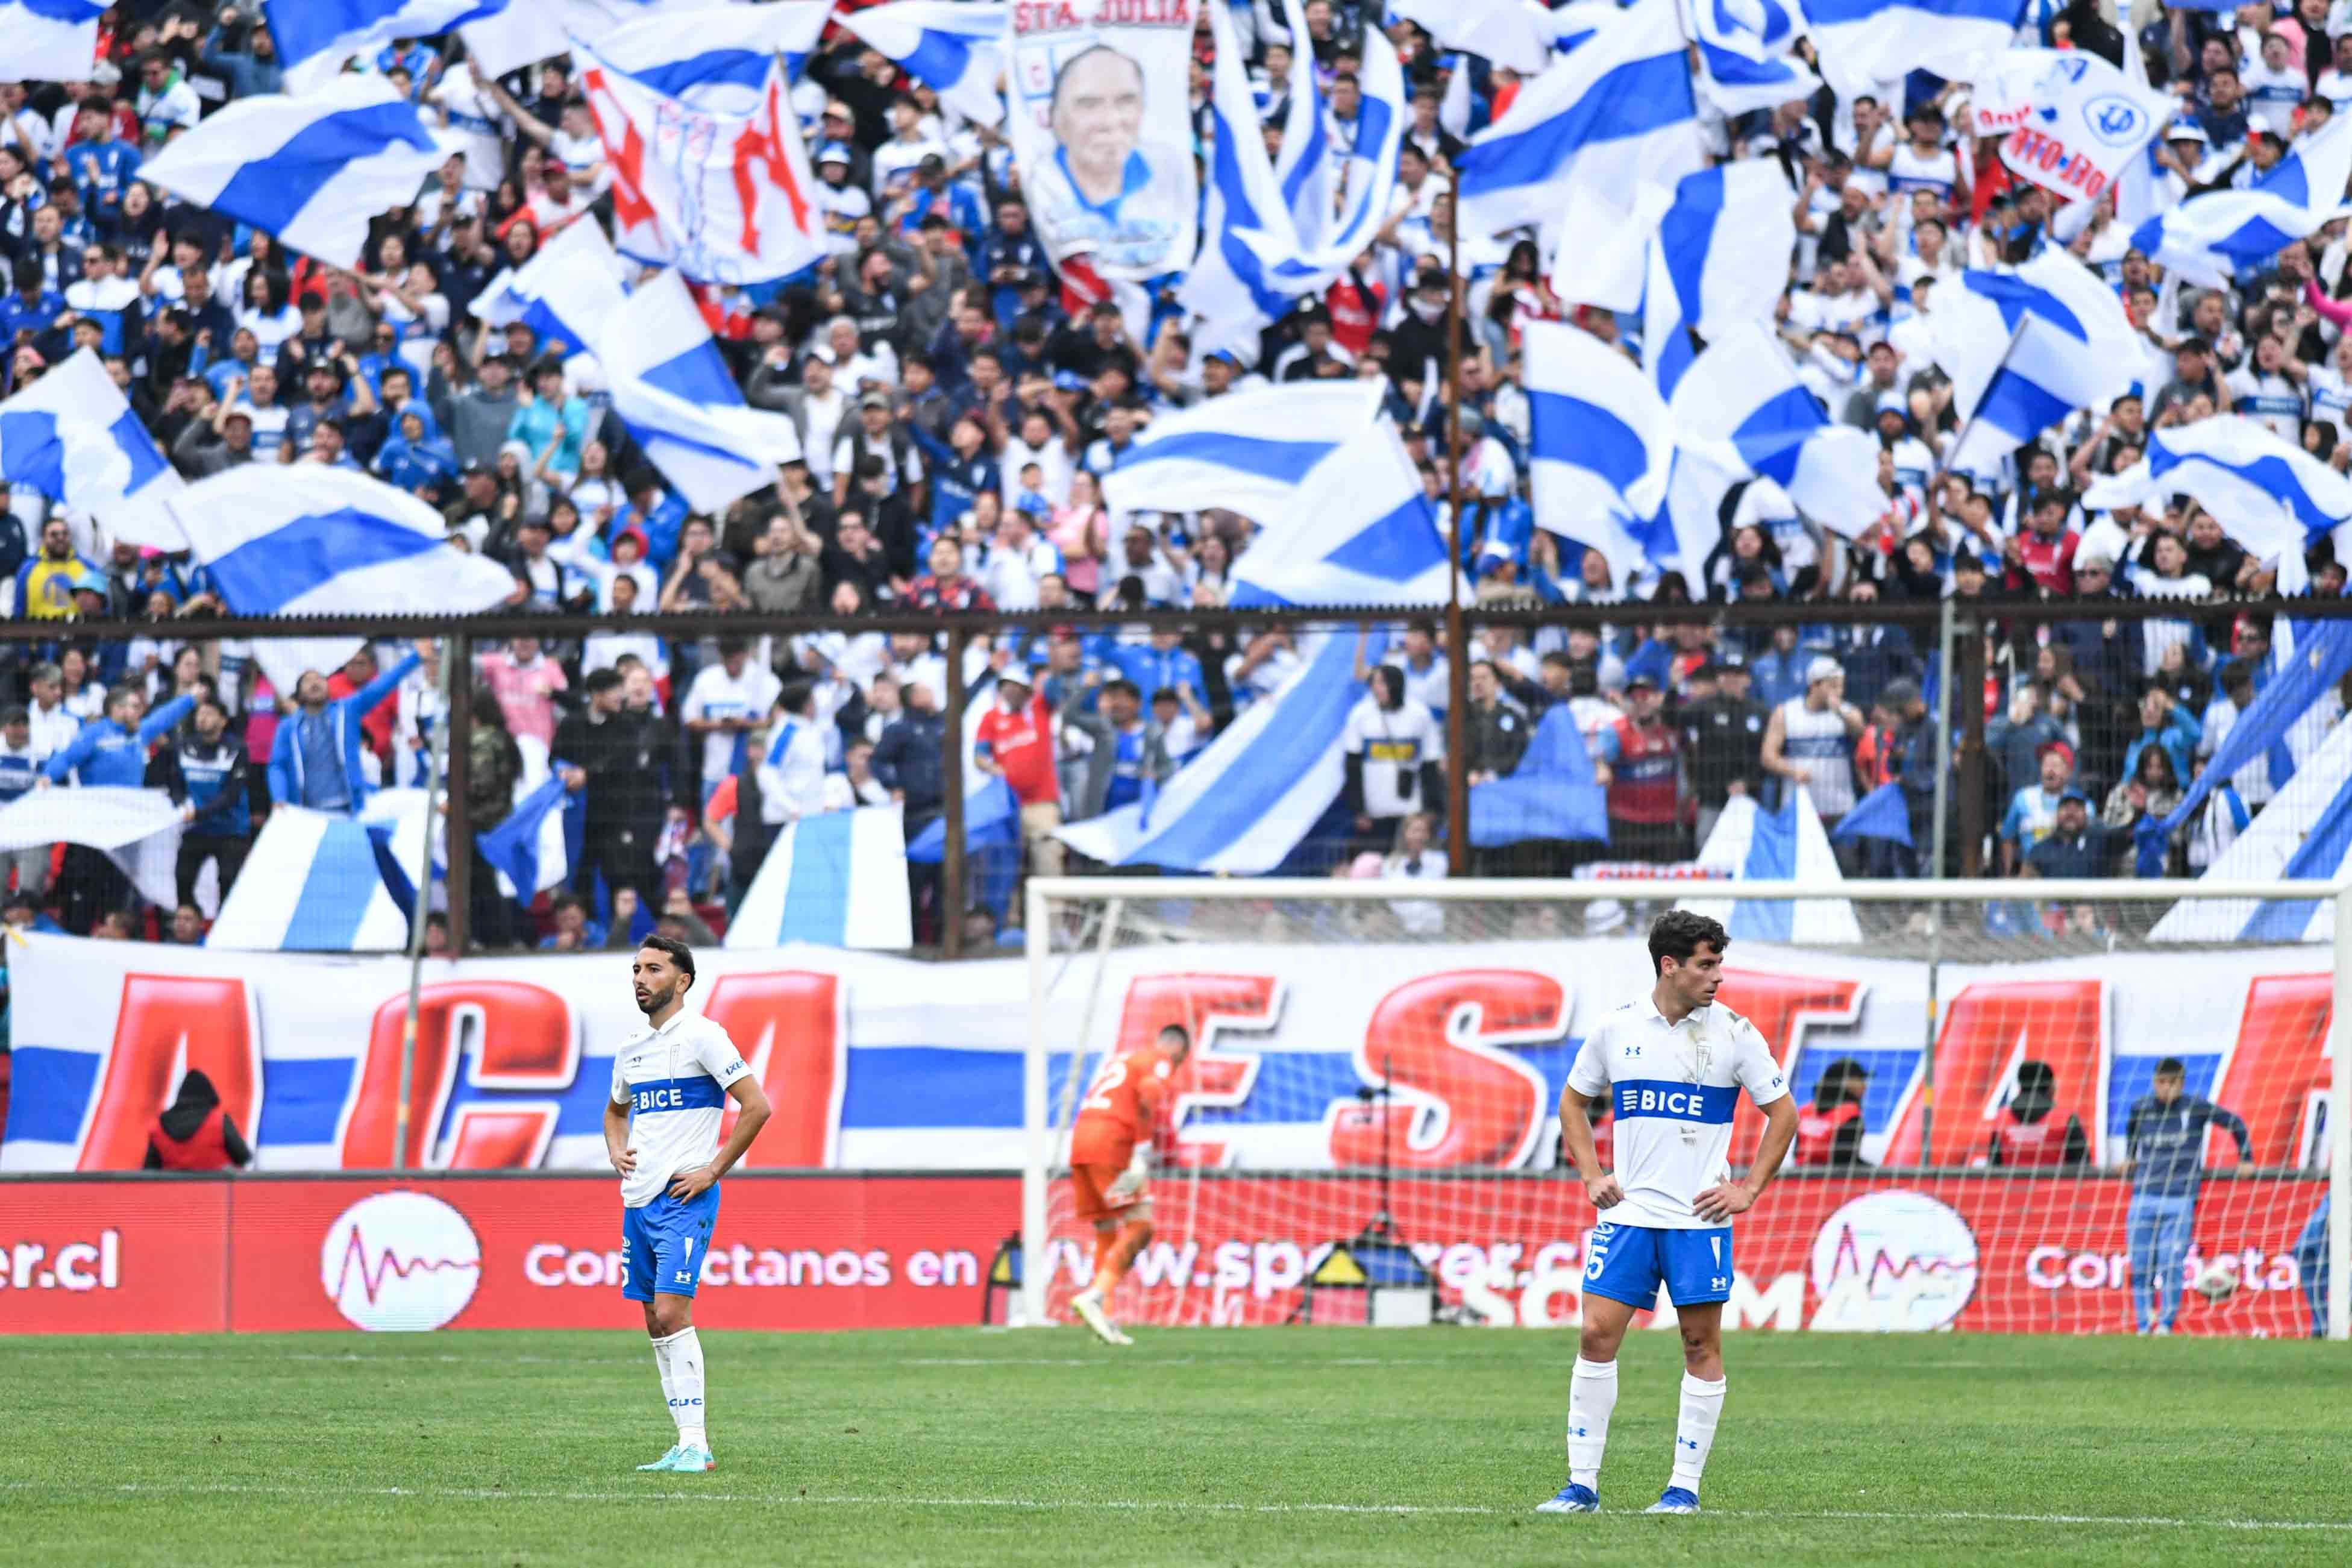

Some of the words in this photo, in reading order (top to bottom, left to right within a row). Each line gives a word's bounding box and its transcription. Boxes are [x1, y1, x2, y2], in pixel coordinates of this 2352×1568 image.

[1015, 1, 1083, 34] STA.
[1093, 0, 1191, 25] JULIA
[76, 969, 845, 1170] ACA
[640, 1088, 684, 1111] BICE
[1640, 1089, 1704, 1117] BICE
[906, 1249, 978, 1287] en
